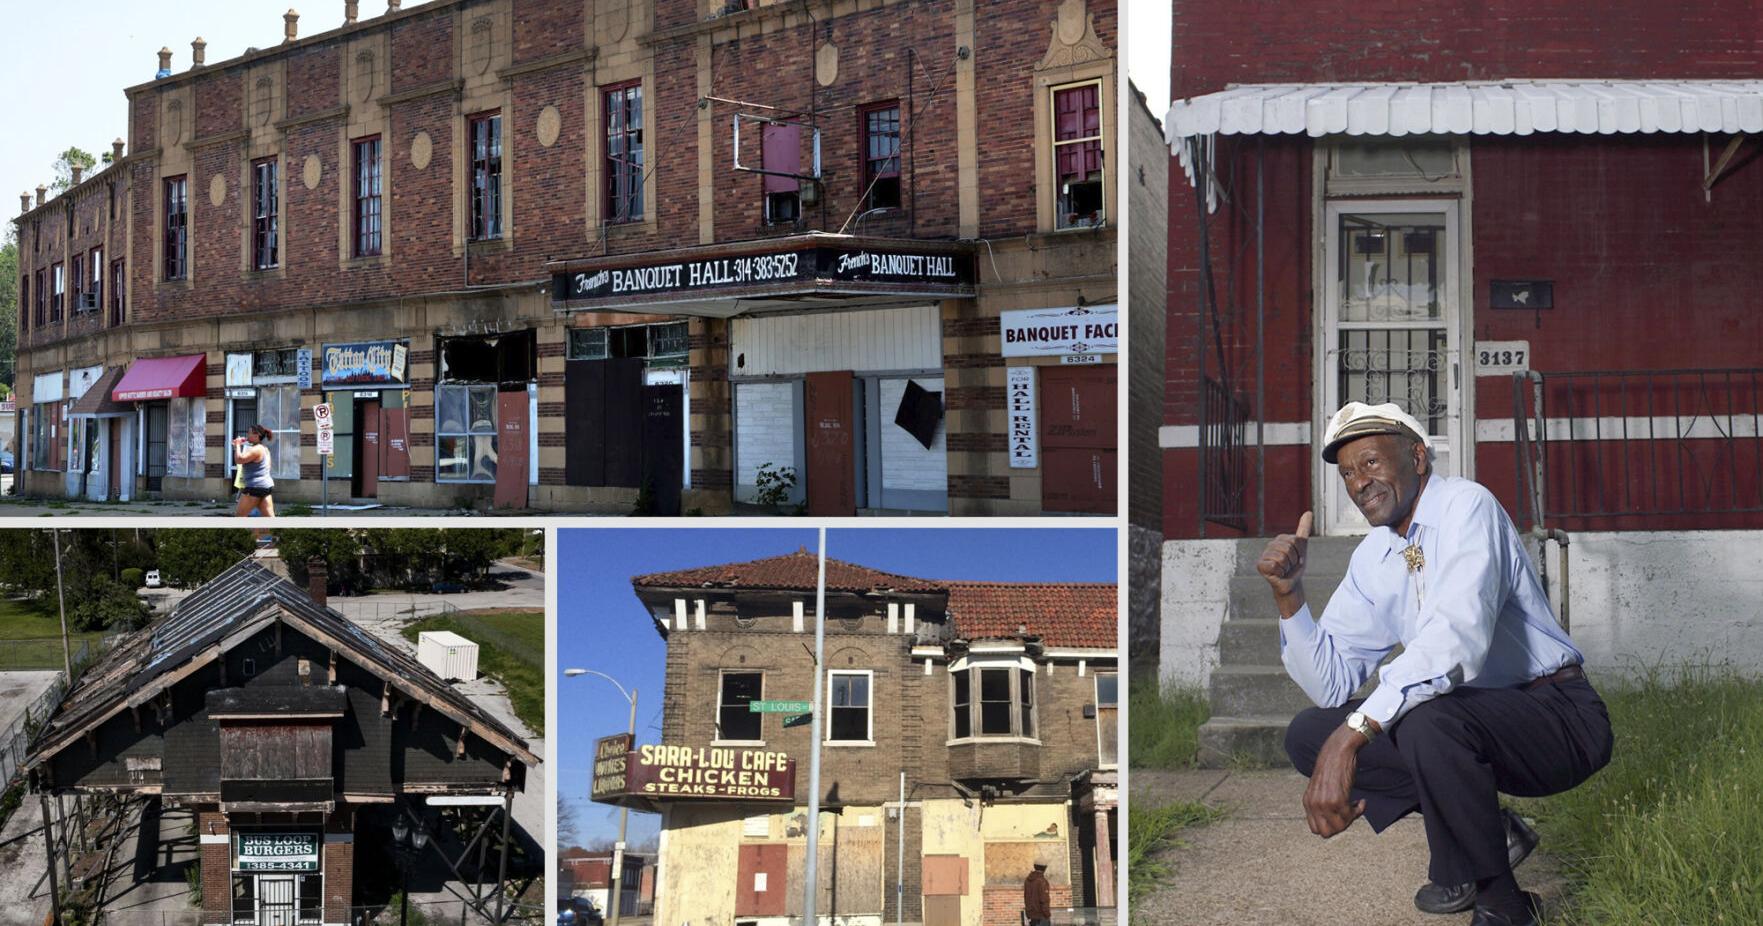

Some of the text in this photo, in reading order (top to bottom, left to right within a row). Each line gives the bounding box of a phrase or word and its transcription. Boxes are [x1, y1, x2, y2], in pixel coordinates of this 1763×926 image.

[871, 254, 924, 275] BANQUET
[926, 256, 956, 276] HALL
[612, 264, 683, 292] BANQUET
[689, 260, 733, 286] HALL
[1006, 325, 1078, 343] BANQUET
[326, 347, 365, 375] Tattoo
[367, 345, 392, 373] City
[1480, 351, 1525, 365] 3137
[1013, 384, 1031, 411] HALL
[1013, 416, 1032, 457] RENTAL
[752, 702, 765, 711] ST
[595, 758, 626, 776] WINES
[640, 745, 788, 771] SARA-LOU CAFE
[593, 775, 626, 794] LIQUORS
[659, 767, 769, 786] CHICKEN
[244, 835, 312, 845] BUS LOOP
[244, 845, 313, 855] BURGERS
